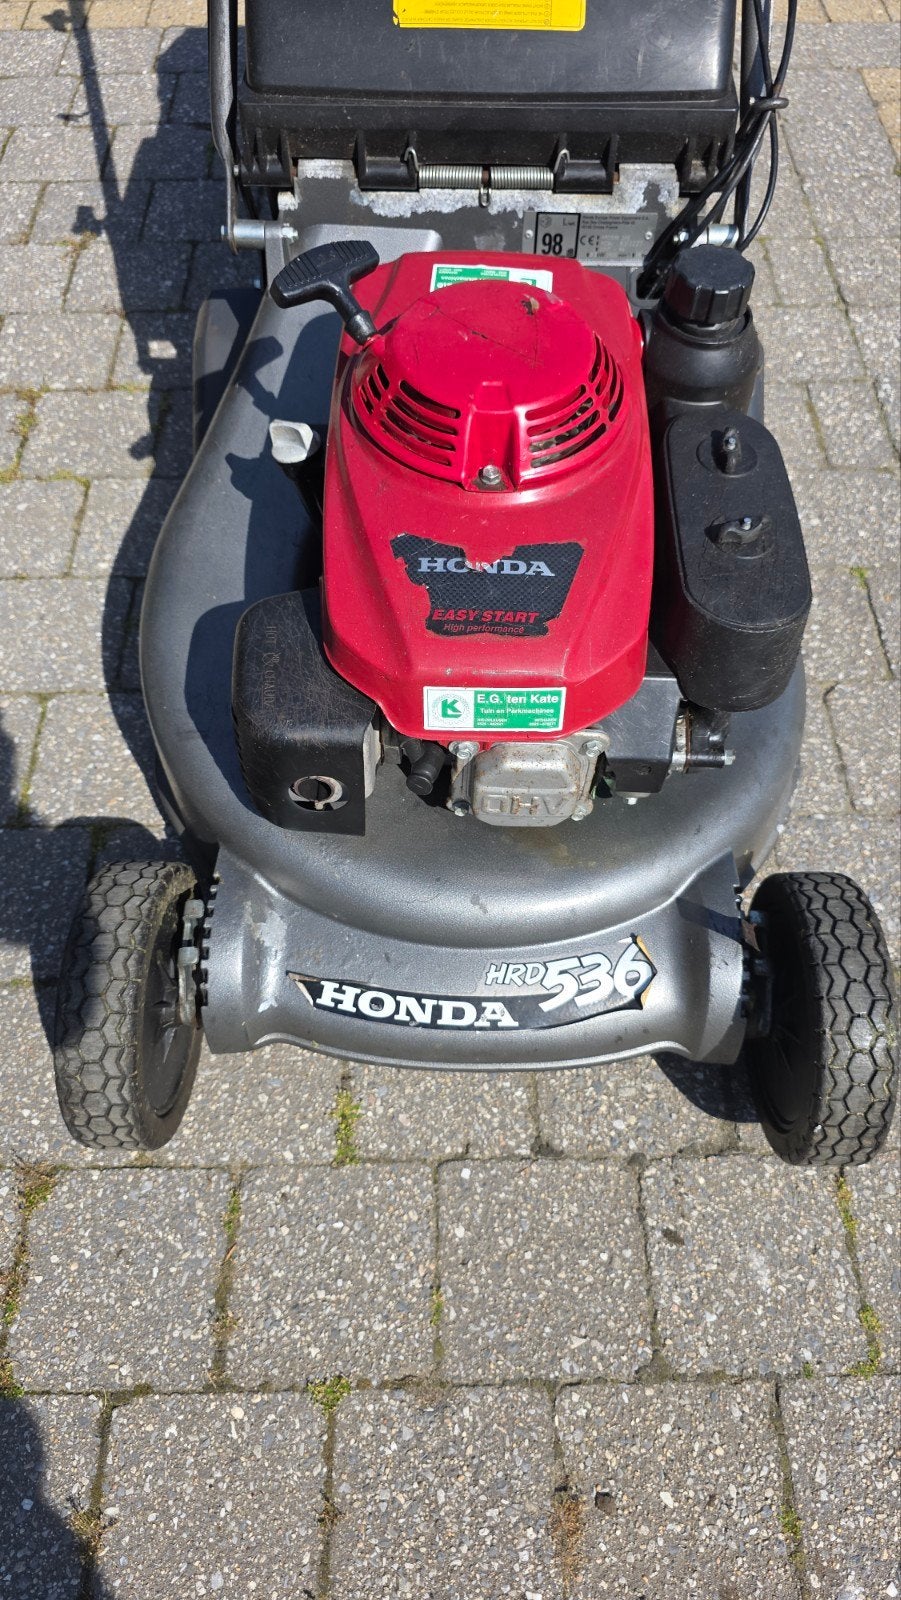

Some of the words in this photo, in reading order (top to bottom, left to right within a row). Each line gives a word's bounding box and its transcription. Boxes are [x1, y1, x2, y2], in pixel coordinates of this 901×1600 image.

[541, 233, 563, 255] 98
[432, 609, 480, 621] EASY
[481, 610, 540, 624] START
[443, 623, 465, 632] High
[466, 624, 525, 634] performance
[477, 694, 503, 704] E.G.
[506, 694, 527, 704] ten
[530, 694, 559, 704] Kate
[485, 961, 544, 987] HRD
[538, 941, 654, 1013] 536
[316, 981, 519, 1028] HONDA
